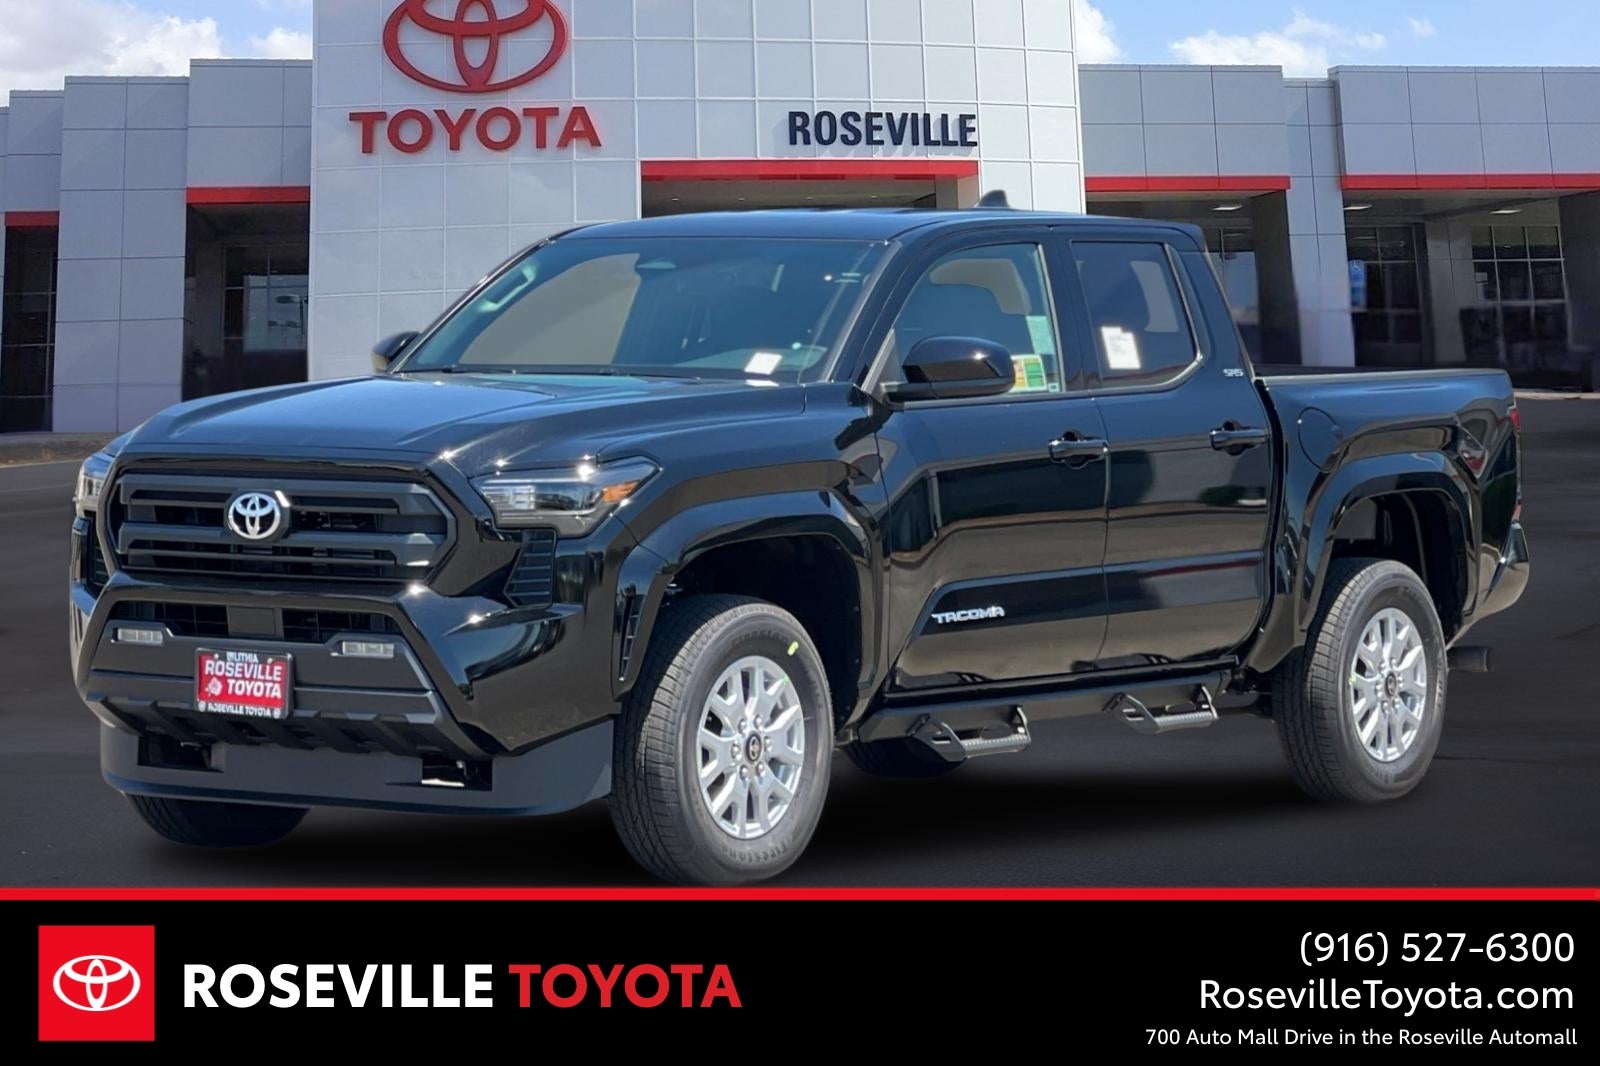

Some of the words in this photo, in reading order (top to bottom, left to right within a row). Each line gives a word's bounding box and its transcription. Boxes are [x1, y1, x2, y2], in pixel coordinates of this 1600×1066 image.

[349, 106, 602, 154] TOYOTA
[788, 111, 978, 148] ROSEVILLE
[931, 606, 1005, 624] TACOMA
[204, 660, 283, 681] ROSEVILLE
[227, 679, 282, 699] TOYOTA
[207, 703, 244, 715] ROSEVILLE
[245, 706, 272, 718] TOYOTA
